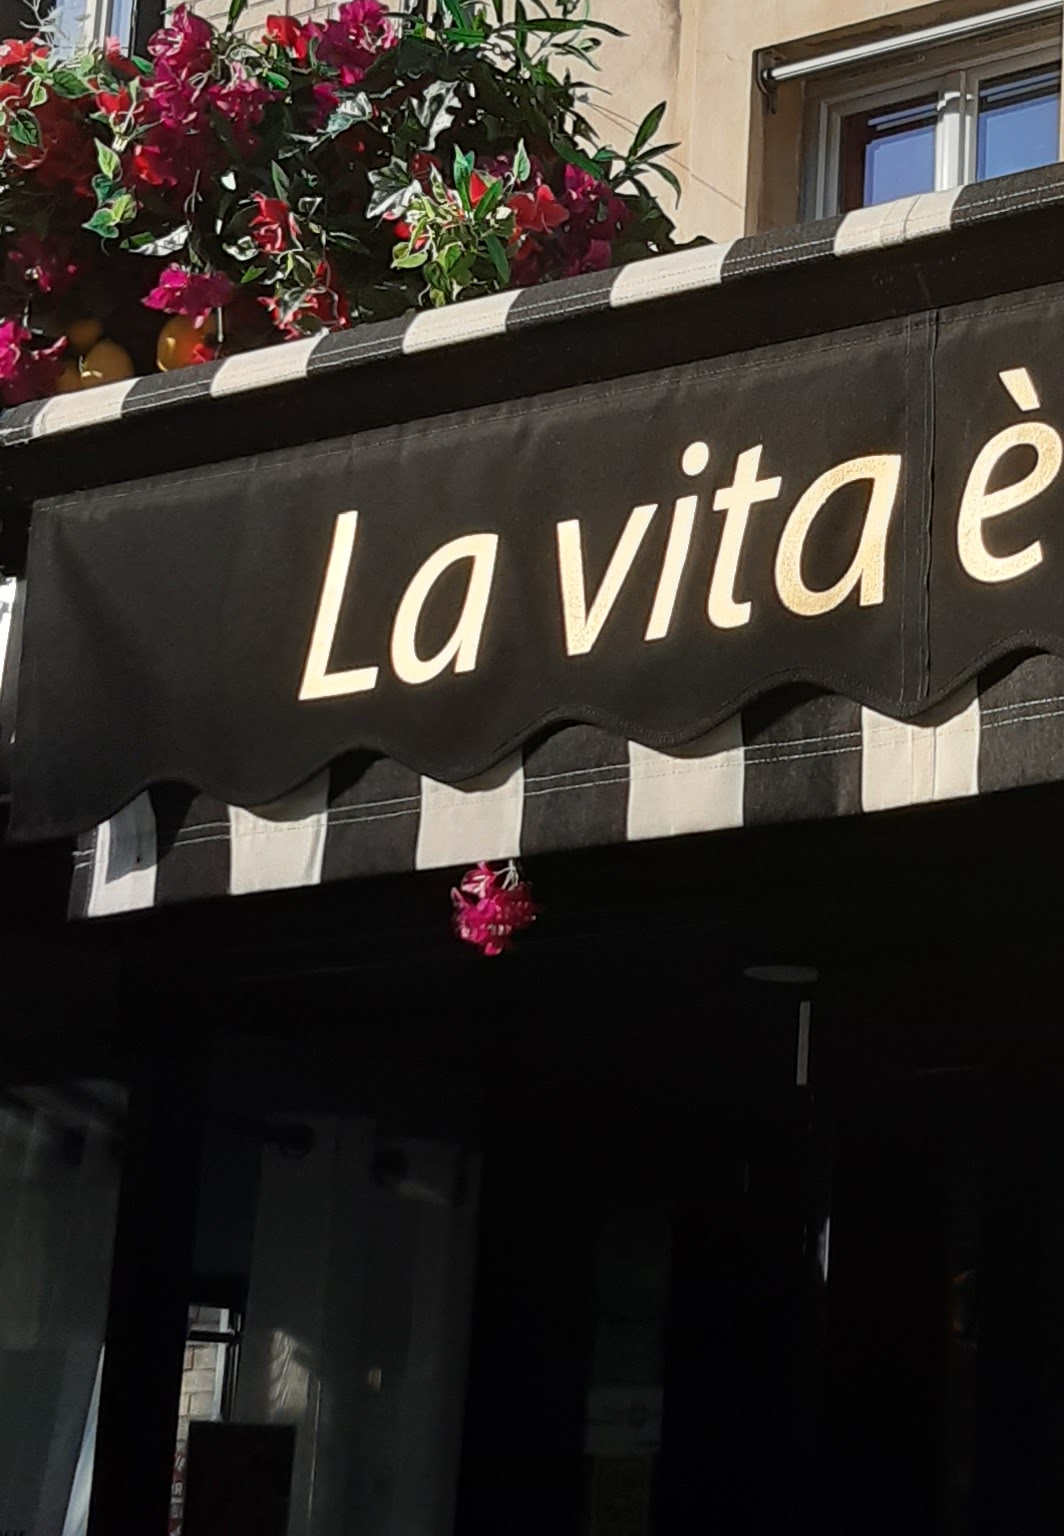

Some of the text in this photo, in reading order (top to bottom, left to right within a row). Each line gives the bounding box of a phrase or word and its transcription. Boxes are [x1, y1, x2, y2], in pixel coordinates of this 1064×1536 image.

[298, 510, 499, 701] La
[556, 439, 902, 657] vita
[956, 366, 1064, 583] è
